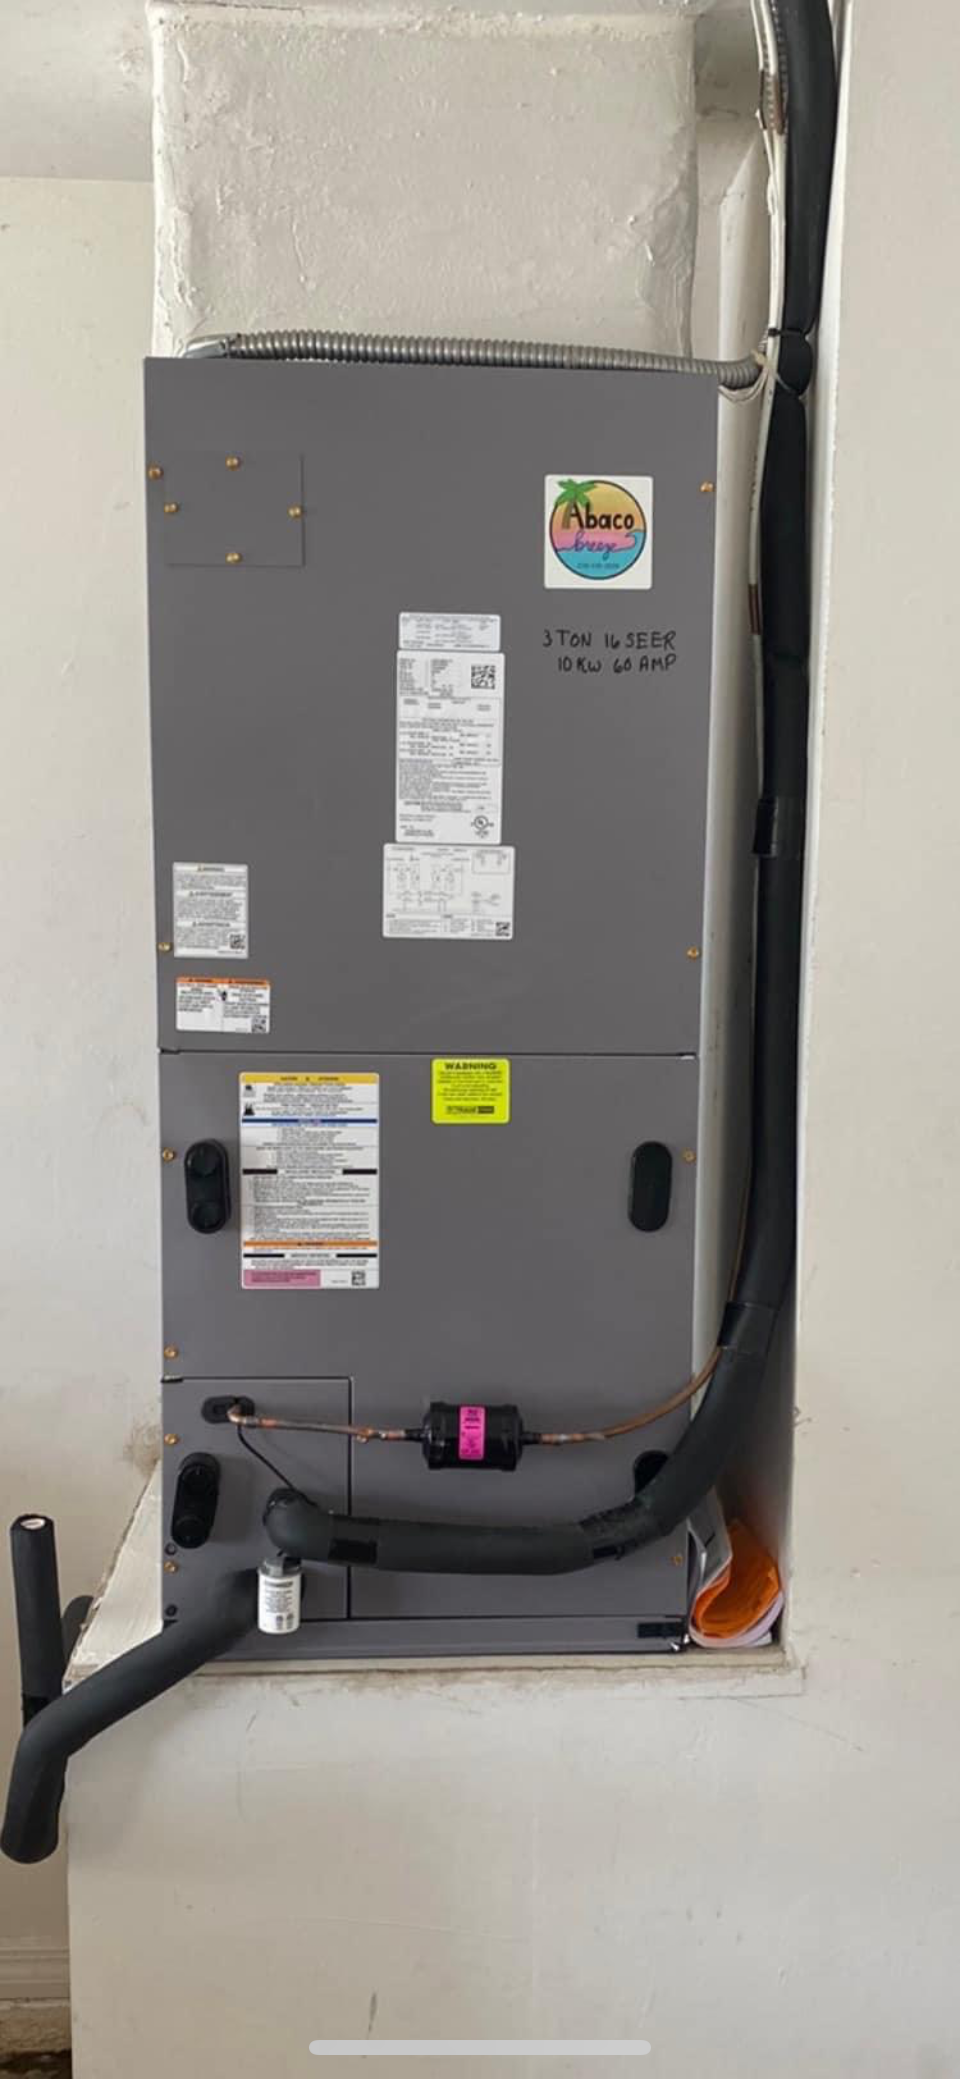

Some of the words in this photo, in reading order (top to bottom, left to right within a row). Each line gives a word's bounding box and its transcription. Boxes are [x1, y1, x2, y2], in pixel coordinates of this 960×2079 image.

[561, 500, 635, 530] Abaco
[542, 629, 553, 648] 3
[555, 629, 592, 648] TON
[604, 632, 620, 650] 16
[625, 630, 677, 651] SEER
[557, 656, 573, 672] 10
[612, 657, 632, 674] 60
[639, 653, 677, 672] AMP
[444, 1062, 497, 1070] WARNING
